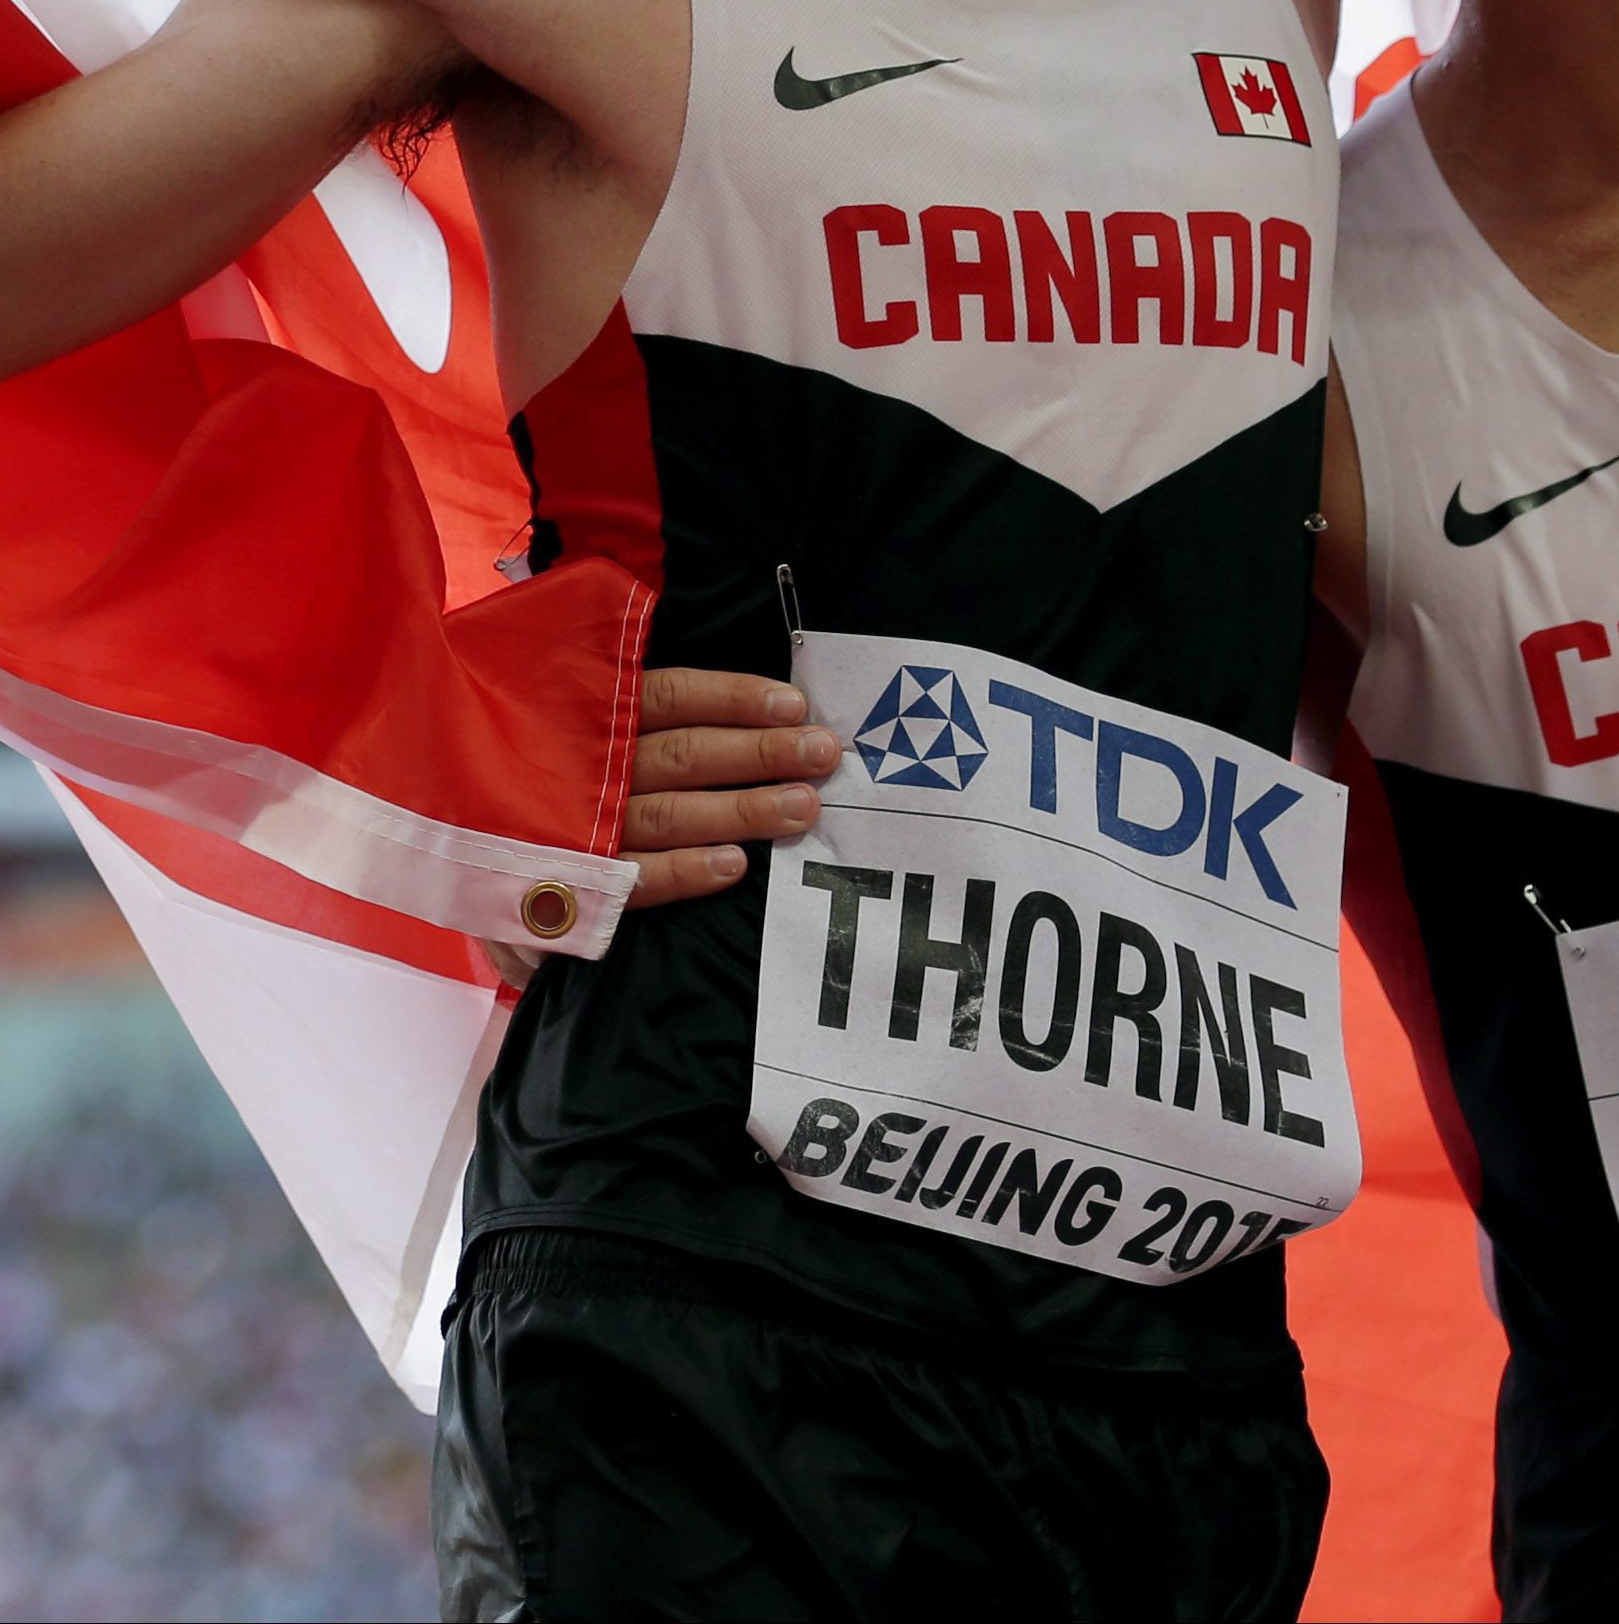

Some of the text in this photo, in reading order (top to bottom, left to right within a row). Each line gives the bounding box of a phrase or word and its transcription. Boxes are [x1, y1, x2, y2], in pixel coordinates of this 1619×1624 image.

[822, 203, 1312, 365] CANADA
[987, 679, 1303, 910] TDK
[801, 860, 1326, 1150] THORNE
[779, 1097, 1123, 1246] BEIJING
